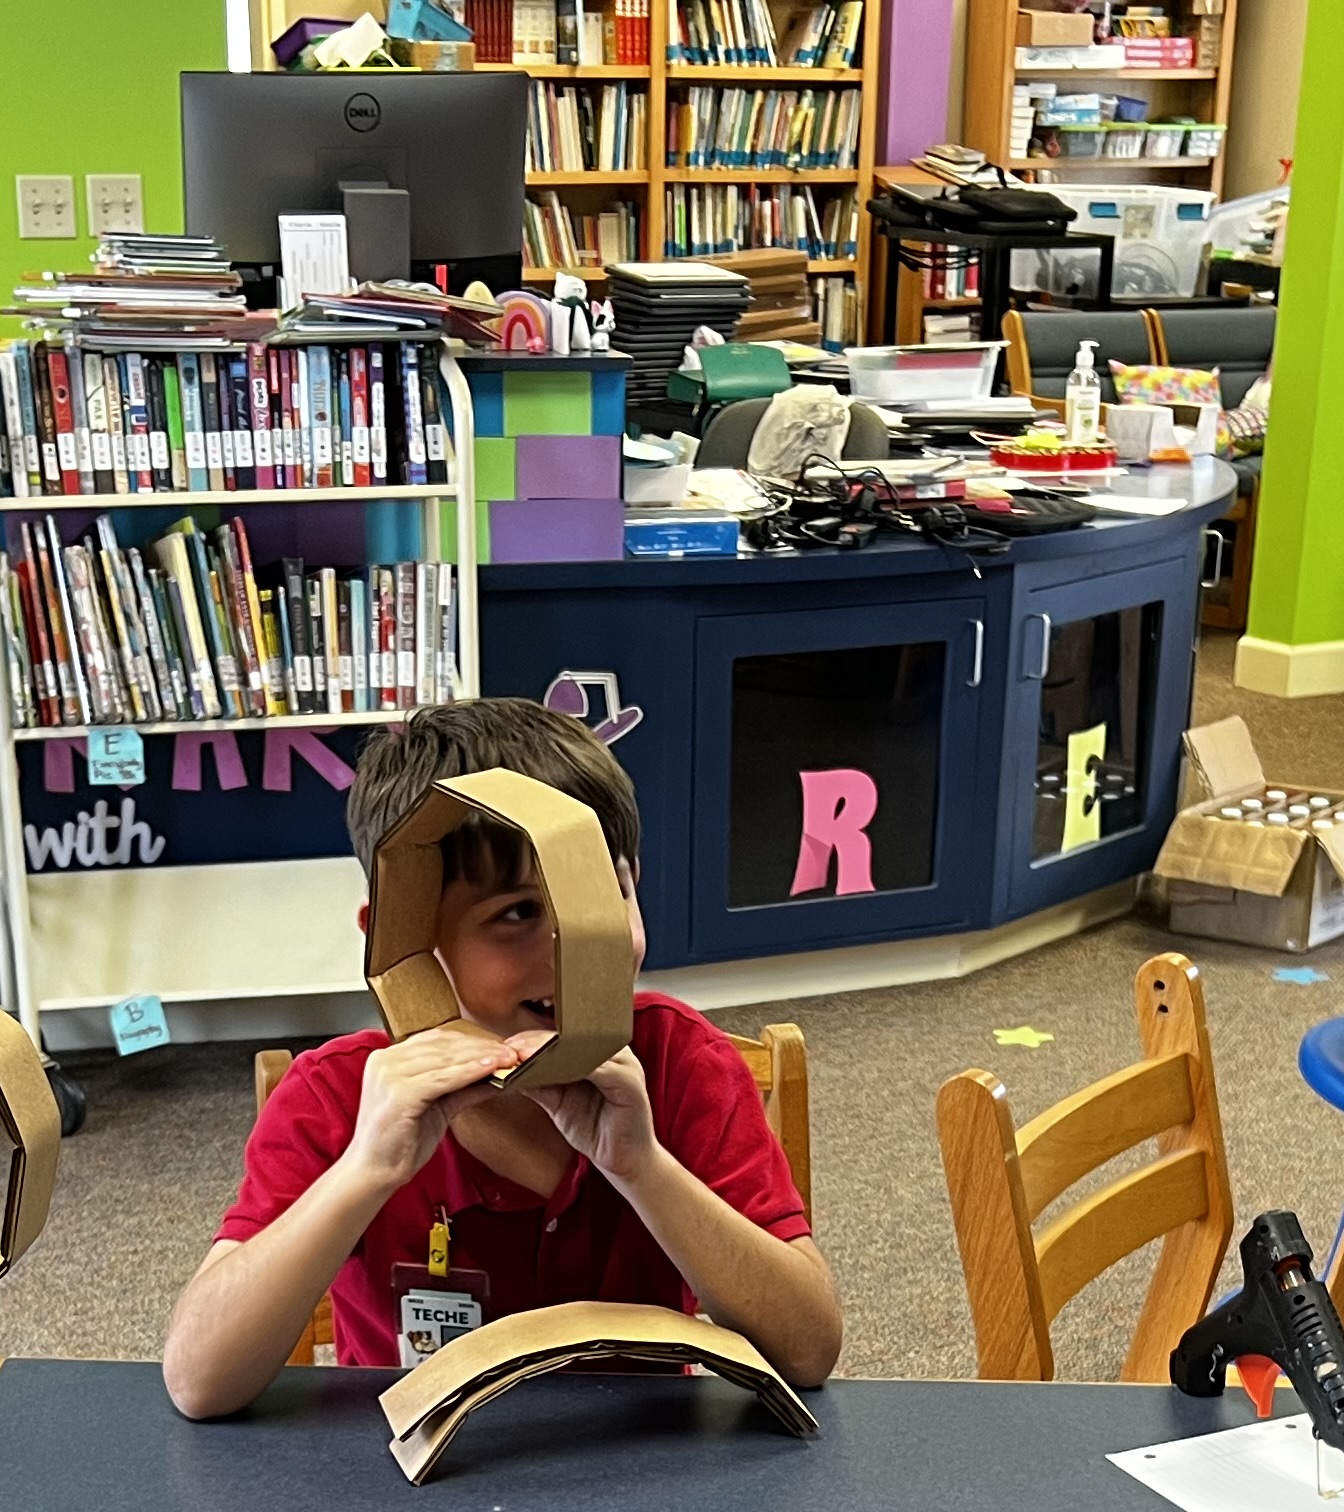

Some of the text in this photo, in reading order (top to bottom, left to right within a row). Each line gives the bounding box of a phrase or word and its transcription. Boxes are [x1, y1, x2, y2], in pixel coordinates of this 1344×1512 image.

[349, 107, 377, 118] DELL
[104, 732, 122, 756] E
[24, 797, 166, 870] with
[790, 769, 878, 896] R
[412, 1307, 469, 1325] TECHE
